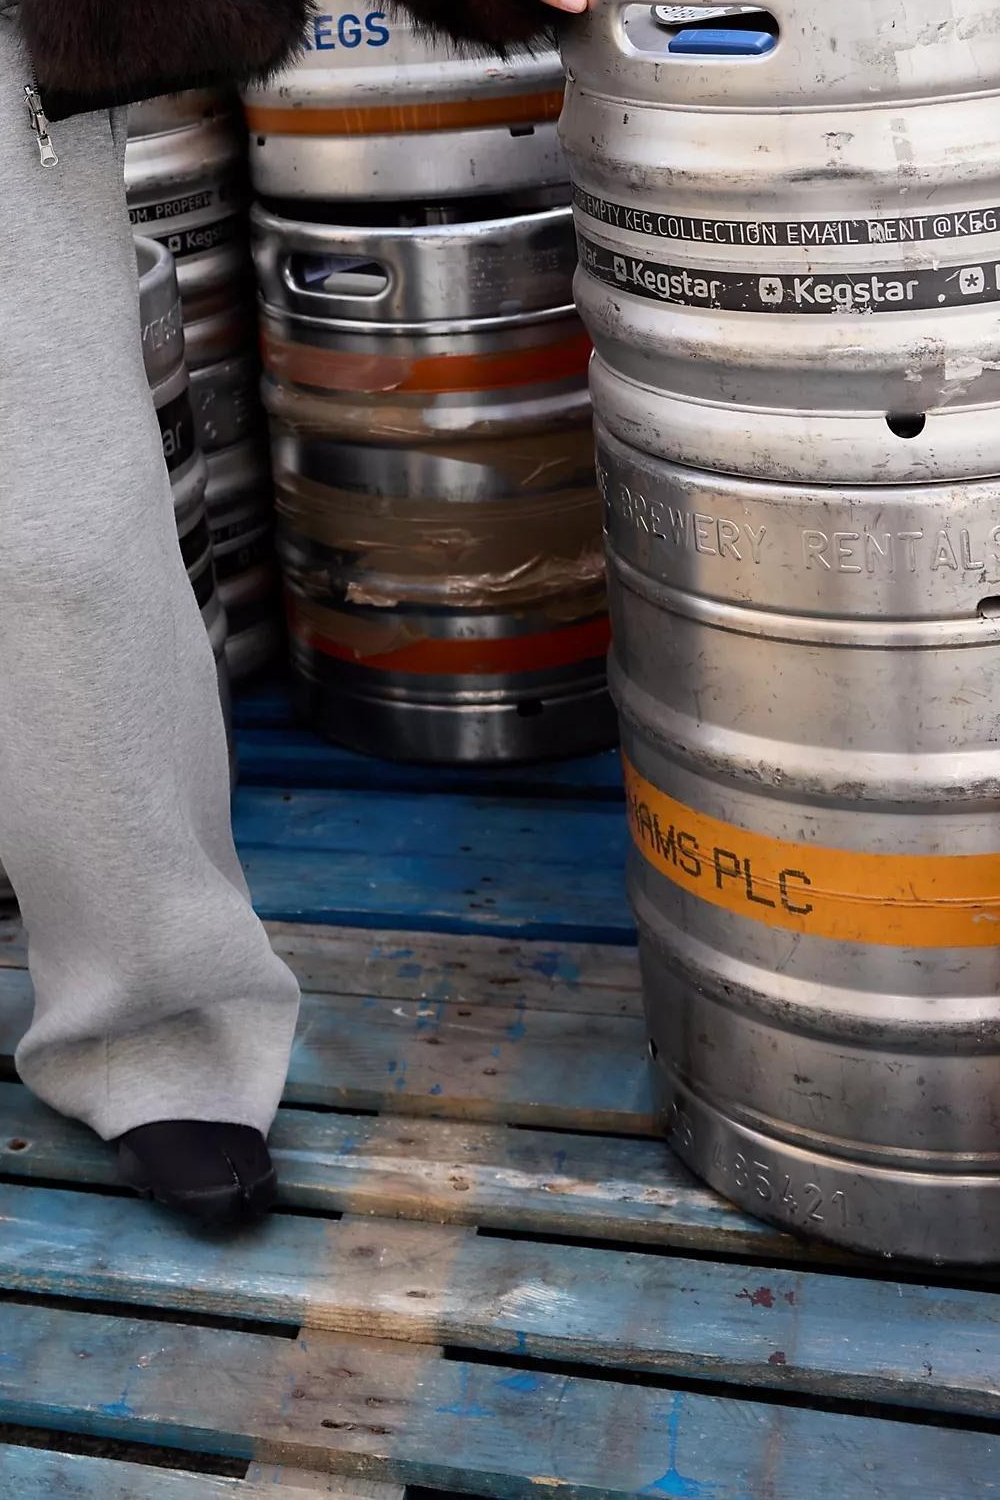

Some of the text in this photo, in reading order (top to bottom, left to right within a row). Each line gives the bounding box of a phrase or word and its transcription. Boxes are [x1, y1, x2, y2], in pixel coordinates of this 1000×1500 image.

[304, 11, 391, 51] EGS
[624, 205, 653, 234] KEG
[657, 213, 778, 245] COLLECTION
[787, 219, 859, 245] EMAIL
[630, 260, 722, 300] Kegstar
[793, 276, 919, 311] Kegstar
[619, 482, 768, 565] BREWERY
[713, 847, 813, 915] PLC
